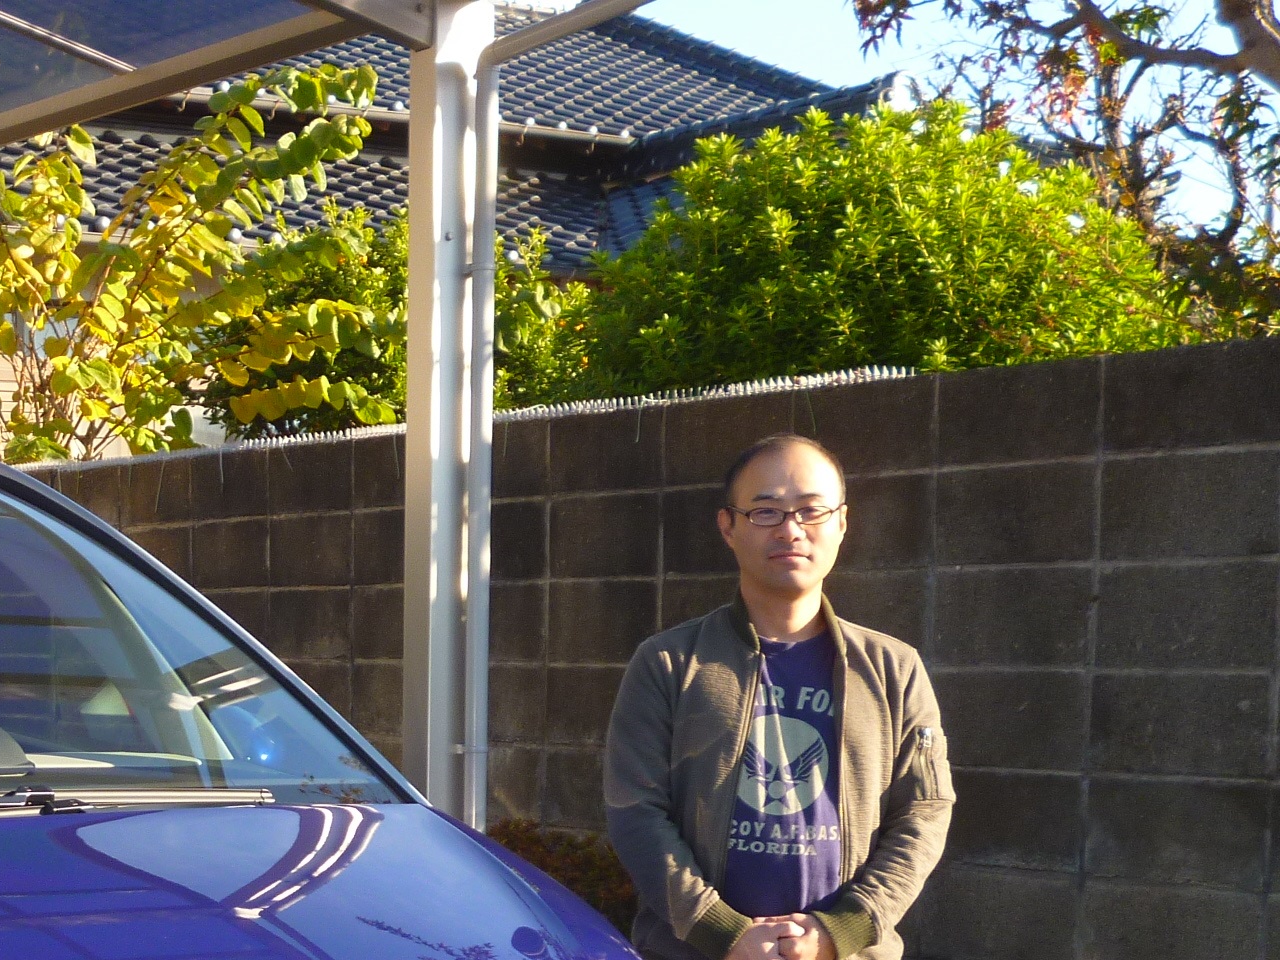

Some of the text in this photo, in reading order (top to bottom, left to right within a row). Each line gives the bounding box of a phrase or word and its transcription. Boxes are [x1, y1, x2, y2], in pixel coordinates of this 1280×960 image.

[754, 683, 785, 709] IR
[770, 823, 841, 841] A.F.BAS
[728, 838, 817, 856] FLORIDA
